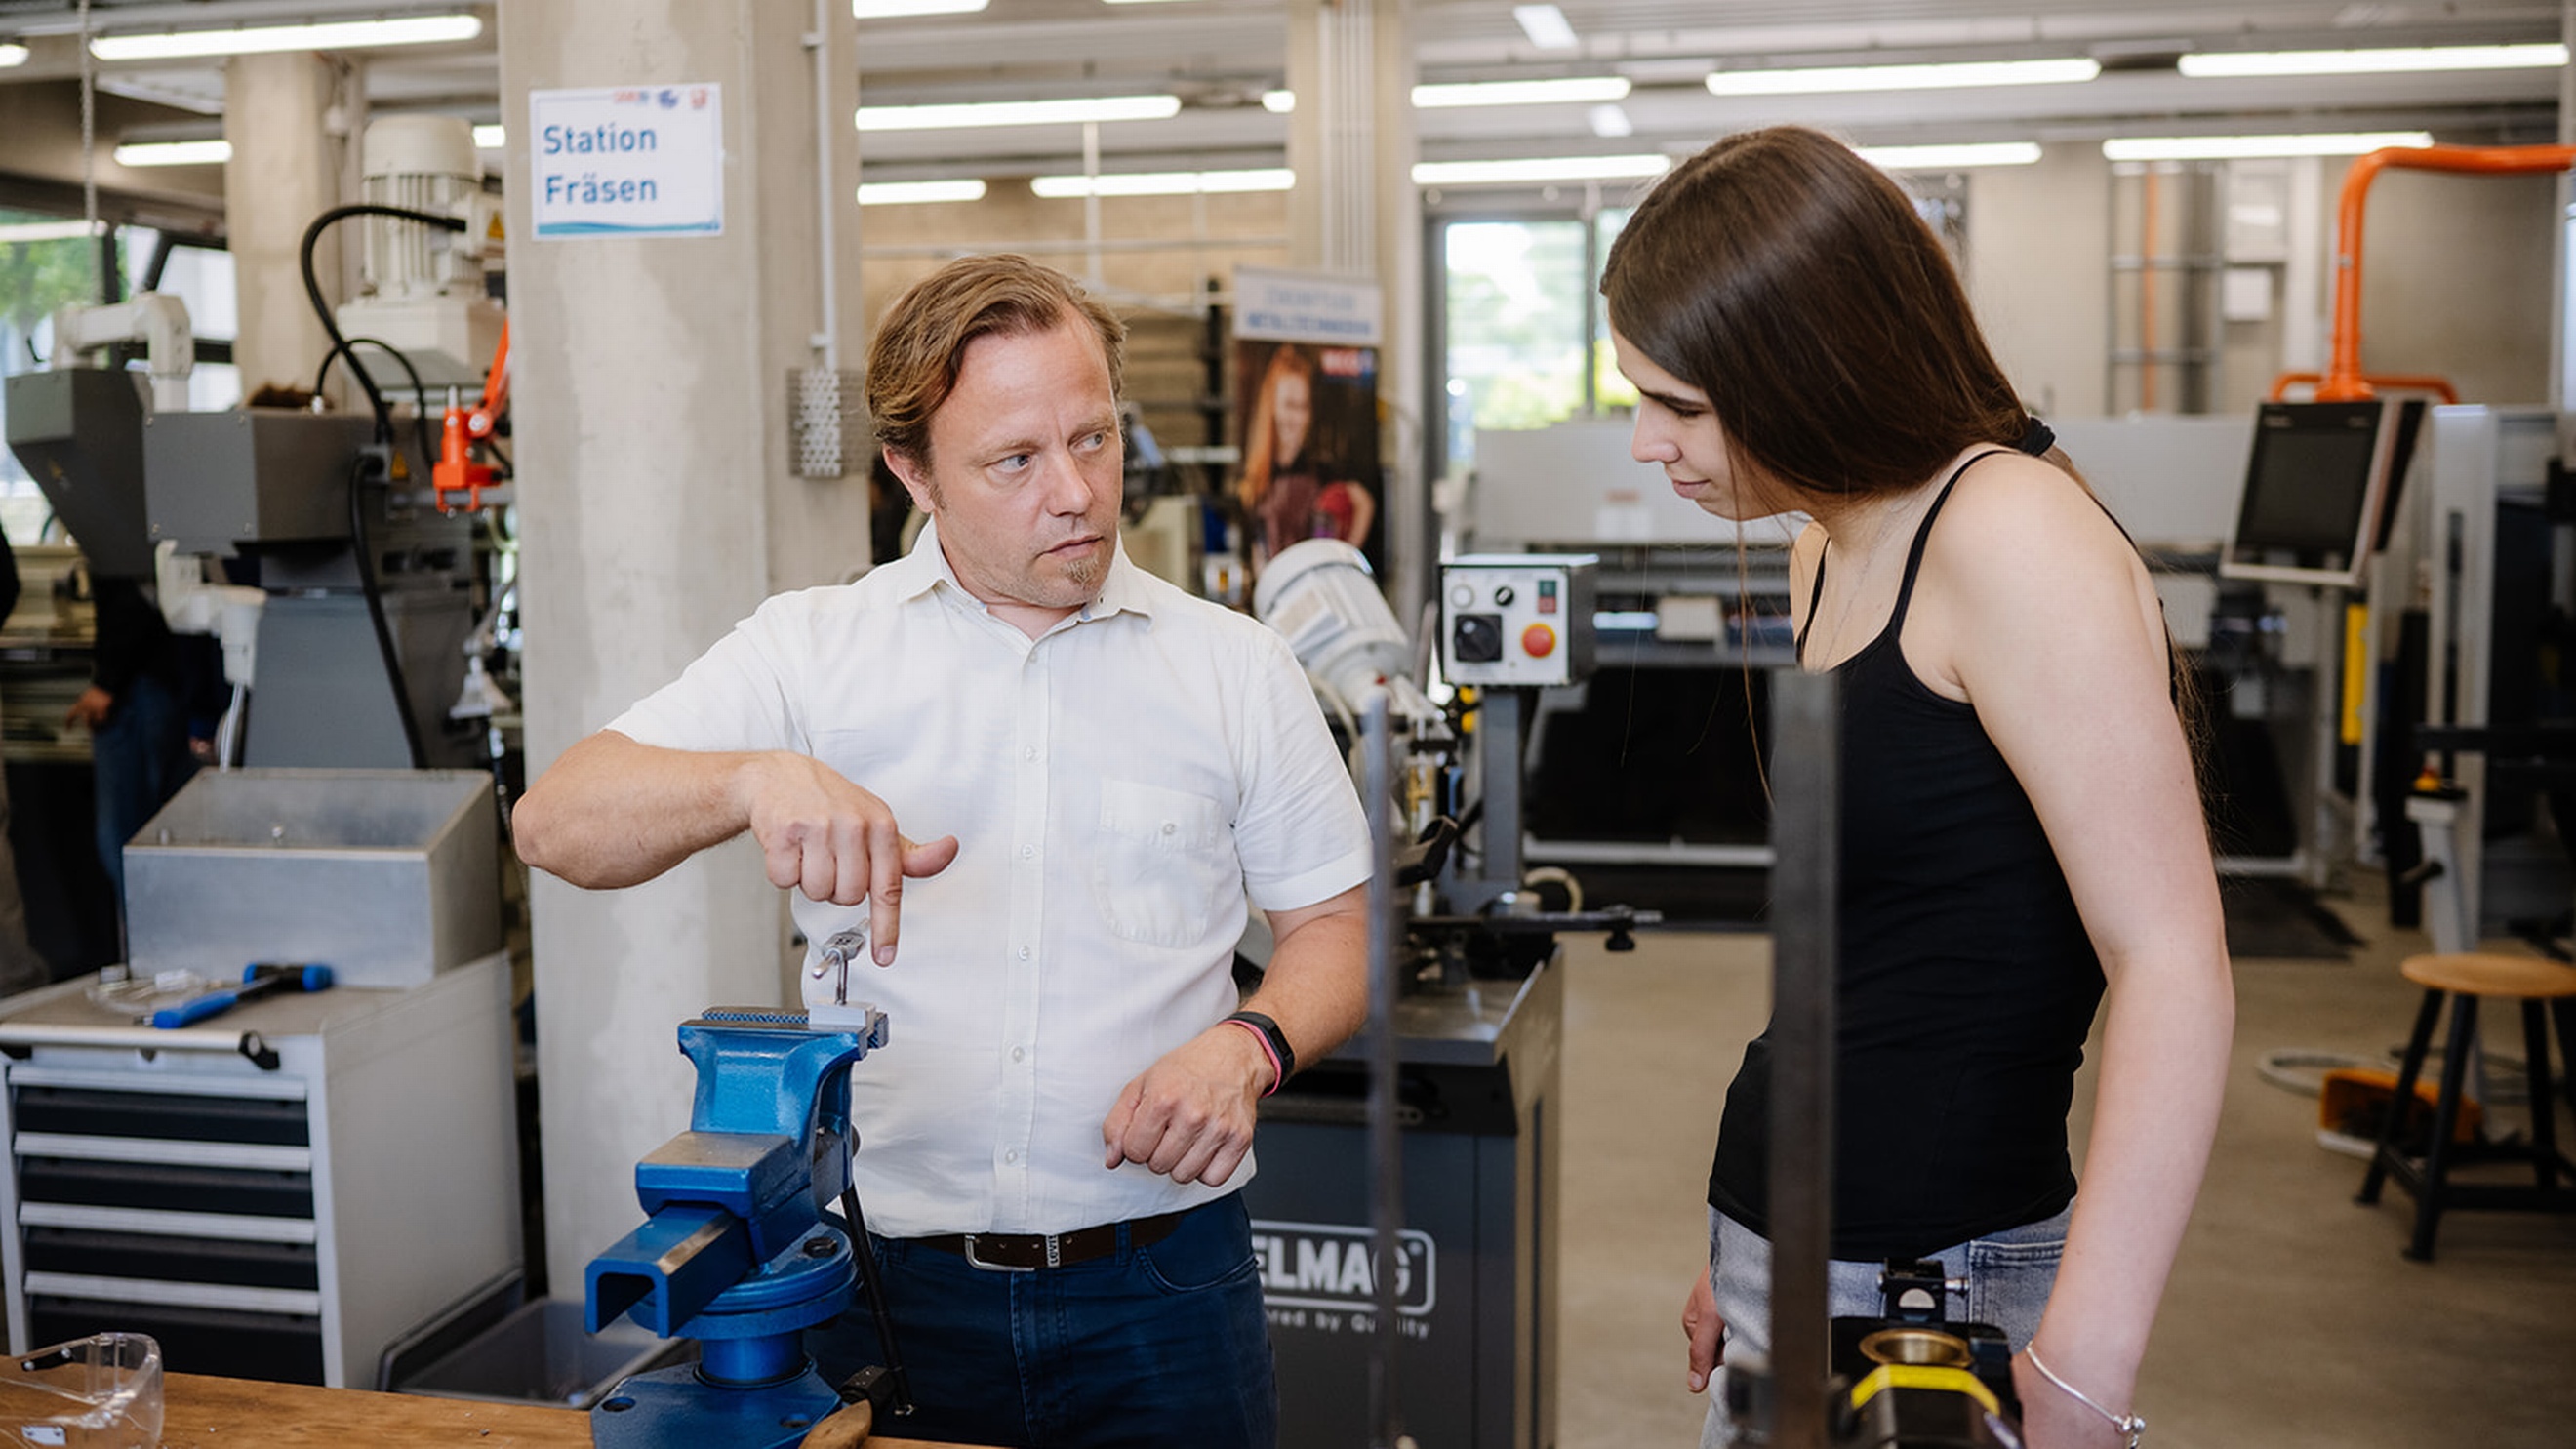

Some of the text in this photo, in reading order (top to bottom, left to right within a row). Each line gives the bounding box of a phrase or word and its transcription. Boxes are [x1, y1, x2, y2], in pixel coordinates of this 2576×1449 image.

[543, 122, 658, 155] Station
[544, 173, 658, 205] Fräsen
[1314, 1311, 1342, 1333] by
[1350, 1313, 1430, 1340] Qulity
